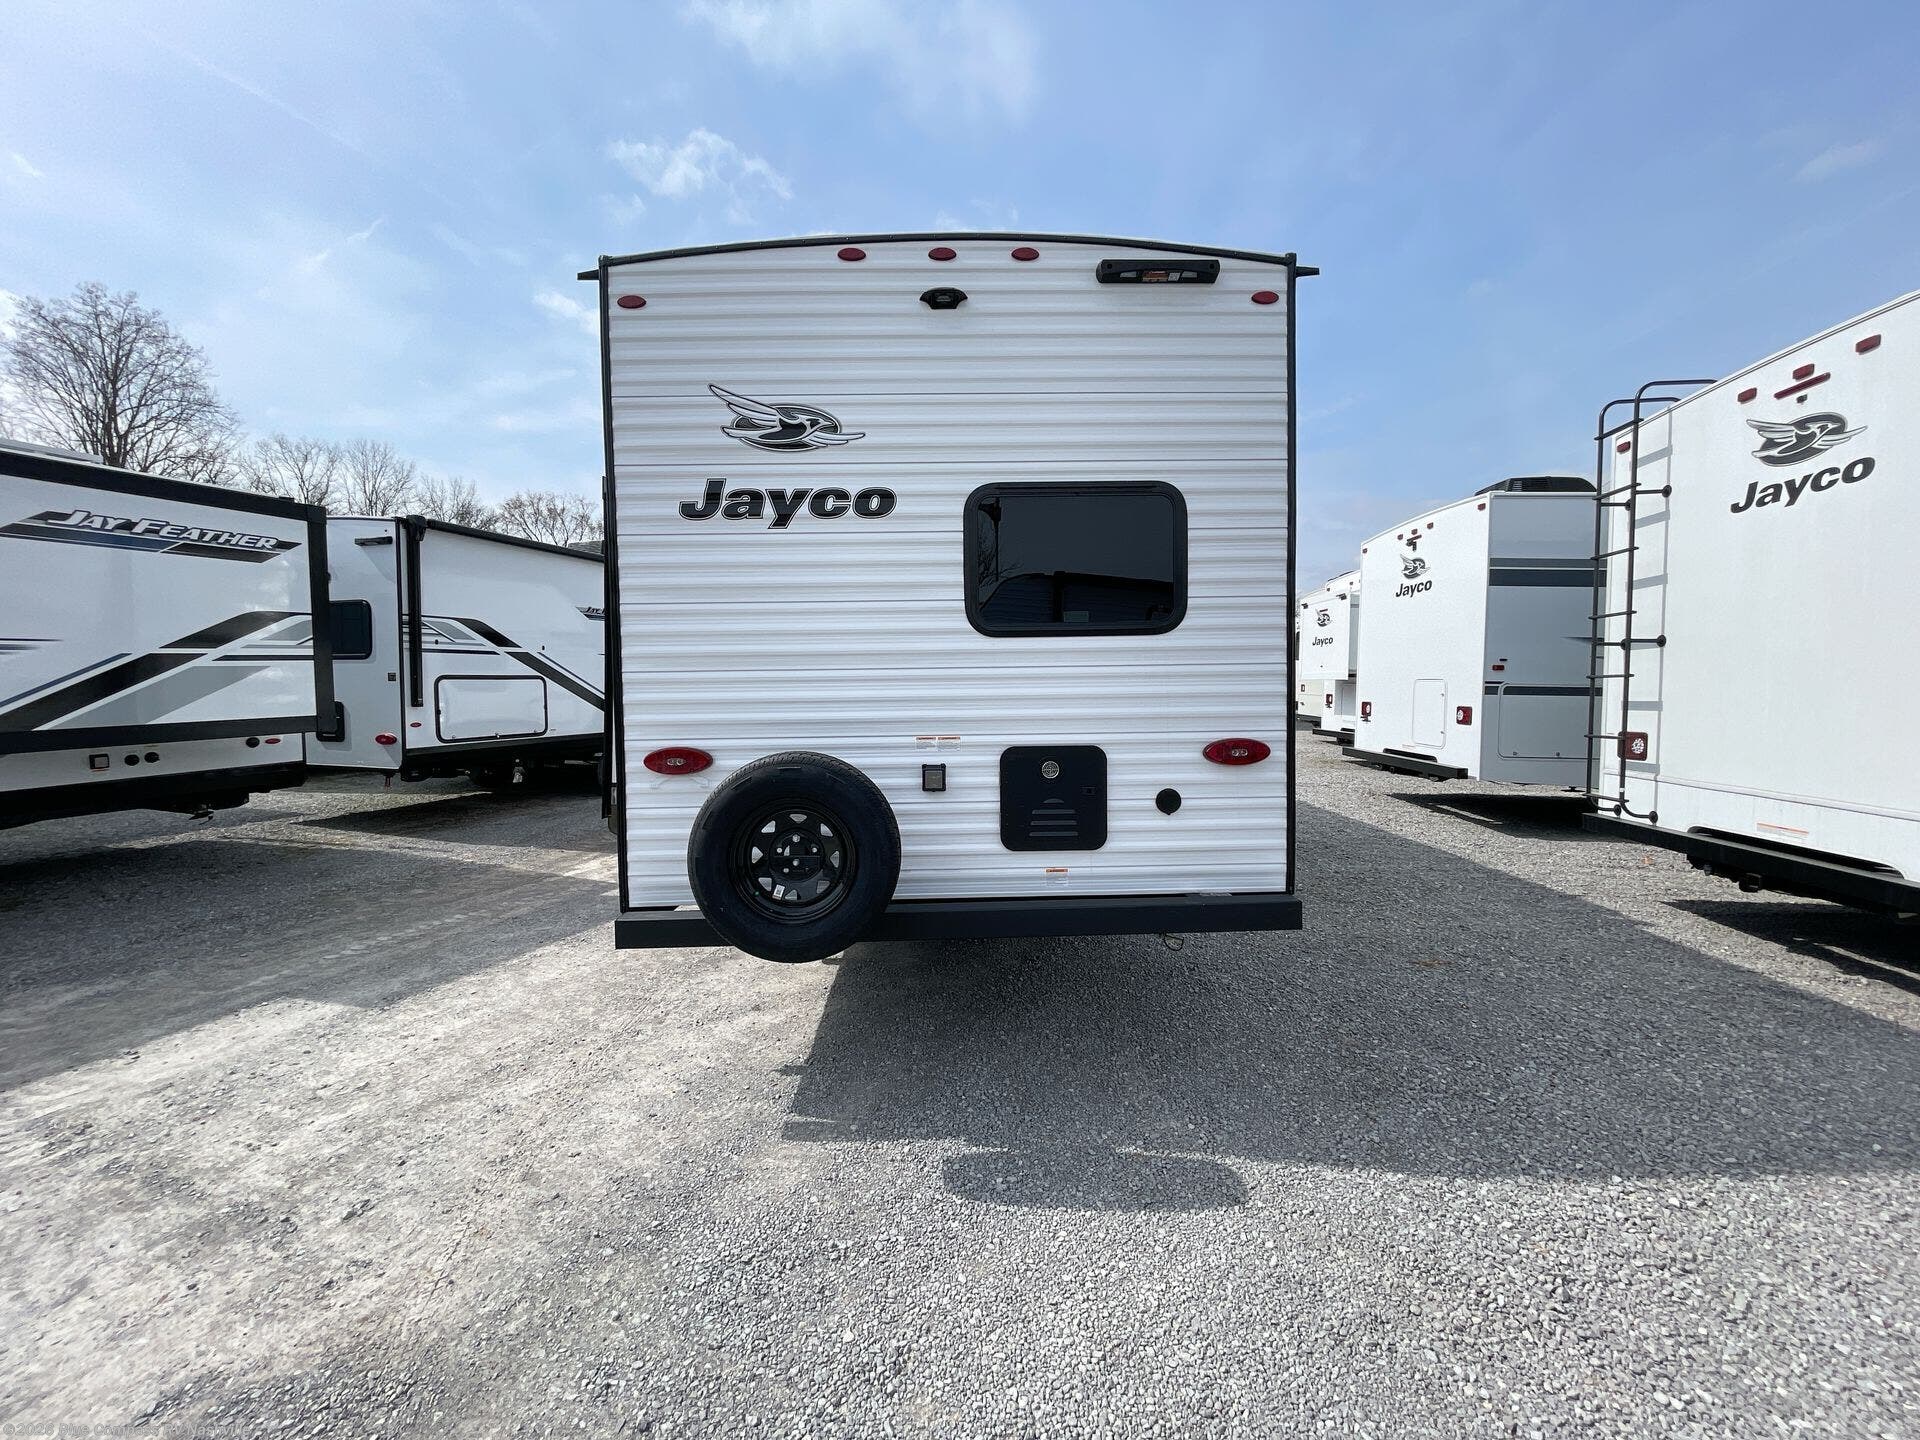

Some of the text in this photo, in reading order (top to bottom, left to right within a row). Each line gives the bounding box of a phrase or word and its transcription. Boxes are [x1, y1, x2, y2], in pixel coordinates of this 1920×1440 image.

[679, 477, 897, 530] Jayco
[1730, 457, 1875, 514] Jayco
[47, 509, 279, 550] JAY FEATHER
[1395, 580, 1433, 598] Jayco
[1312, 636, 1334, 647] Jayco
